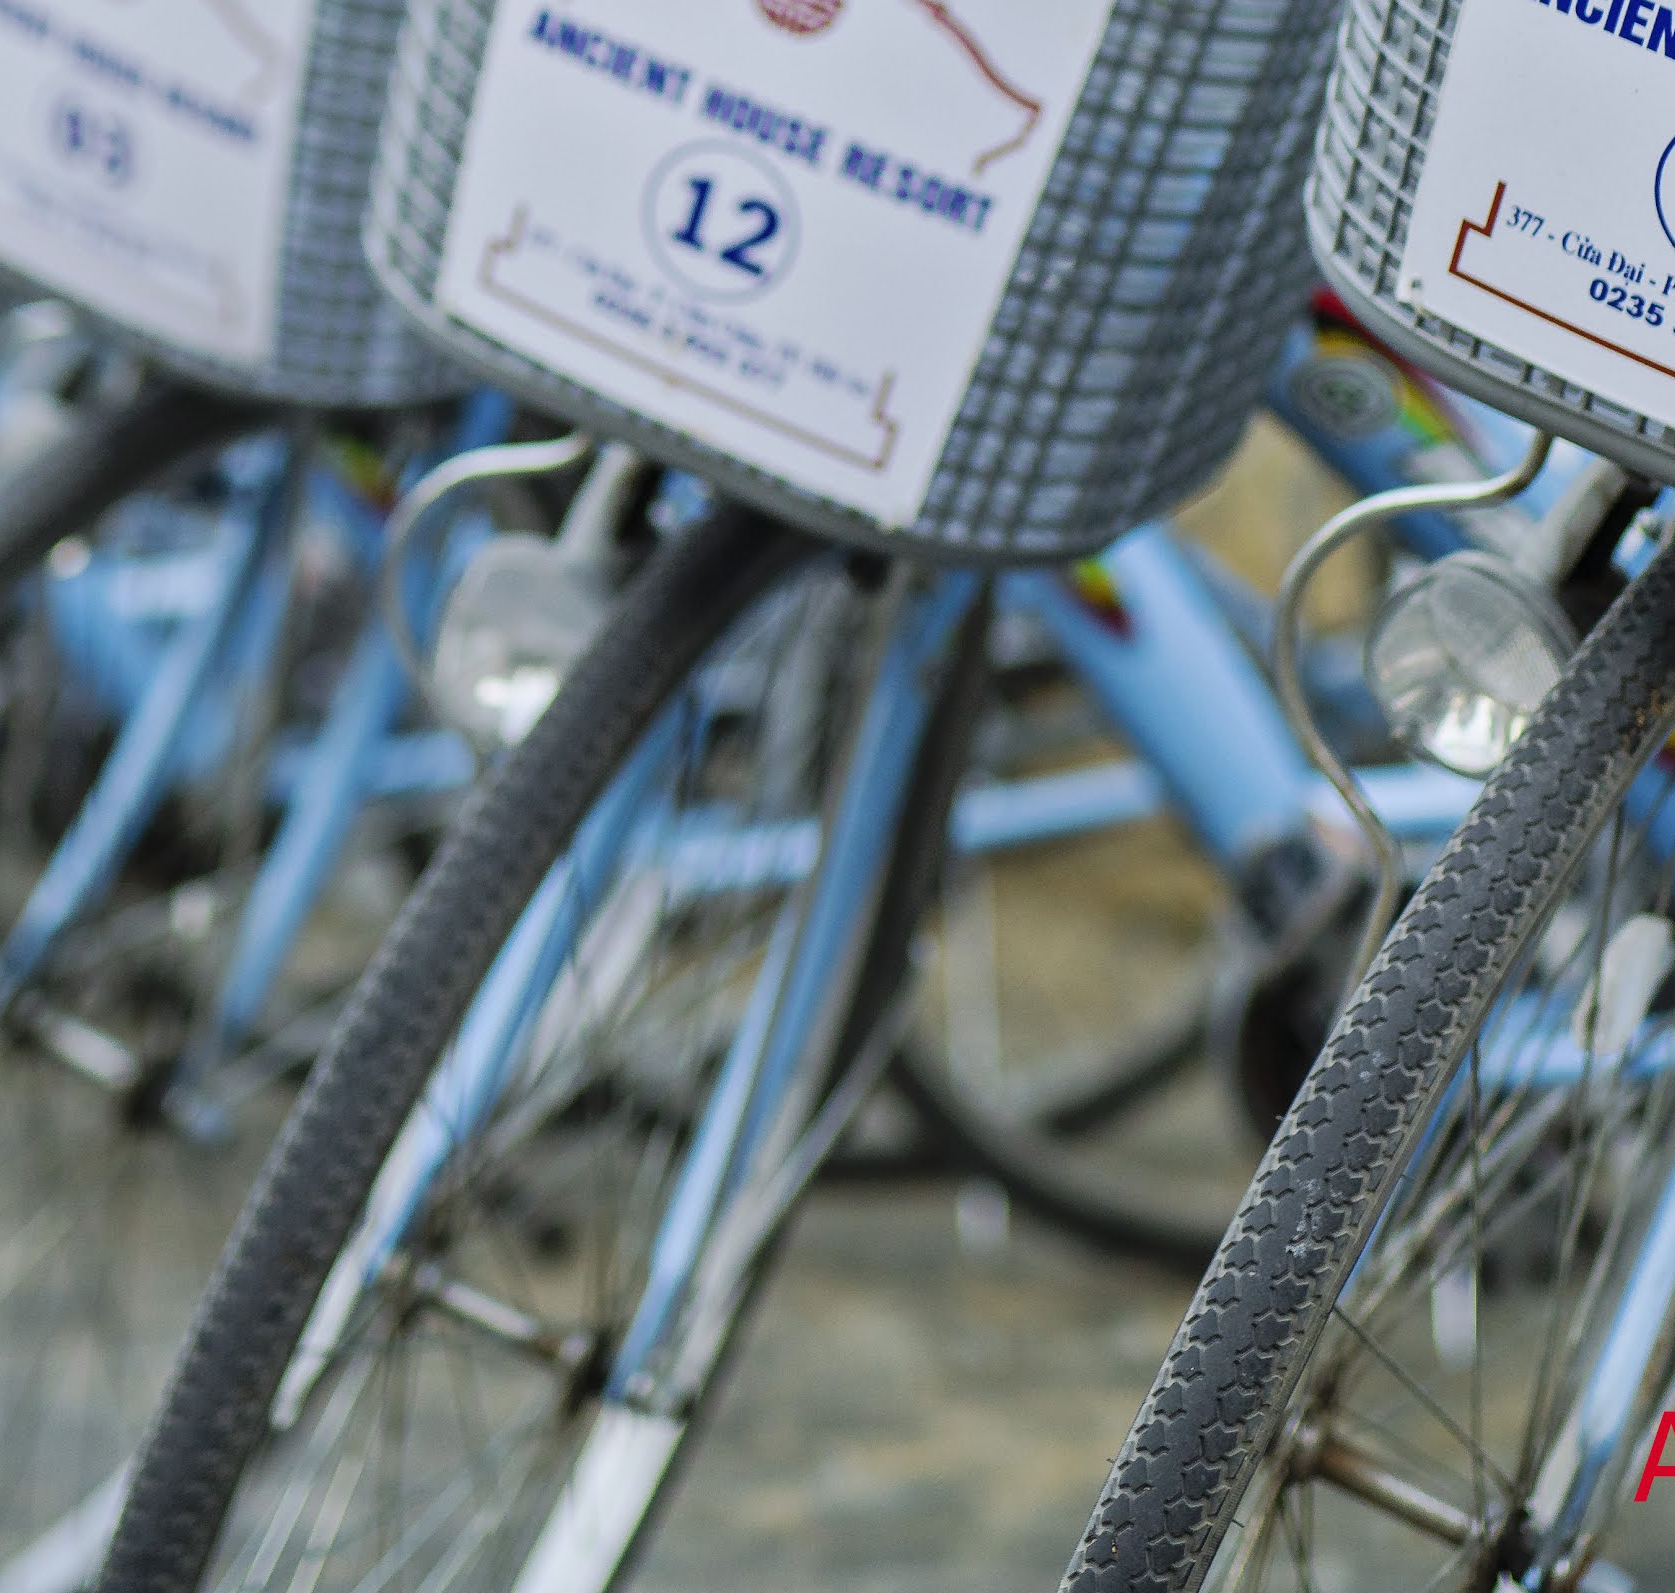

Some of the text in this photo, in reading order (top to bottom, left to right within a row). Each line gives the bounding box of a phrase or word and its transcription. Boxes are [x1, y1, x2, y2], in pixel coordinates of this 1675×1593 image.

[671, 174, 783, 280] 12
[1506, 205, 1545, 236] 377
[1562, 231, 1602, 267] Cửa
[1607, 250, 1646, 286] Đại
[1589, 278, 1665, 327] 0235
